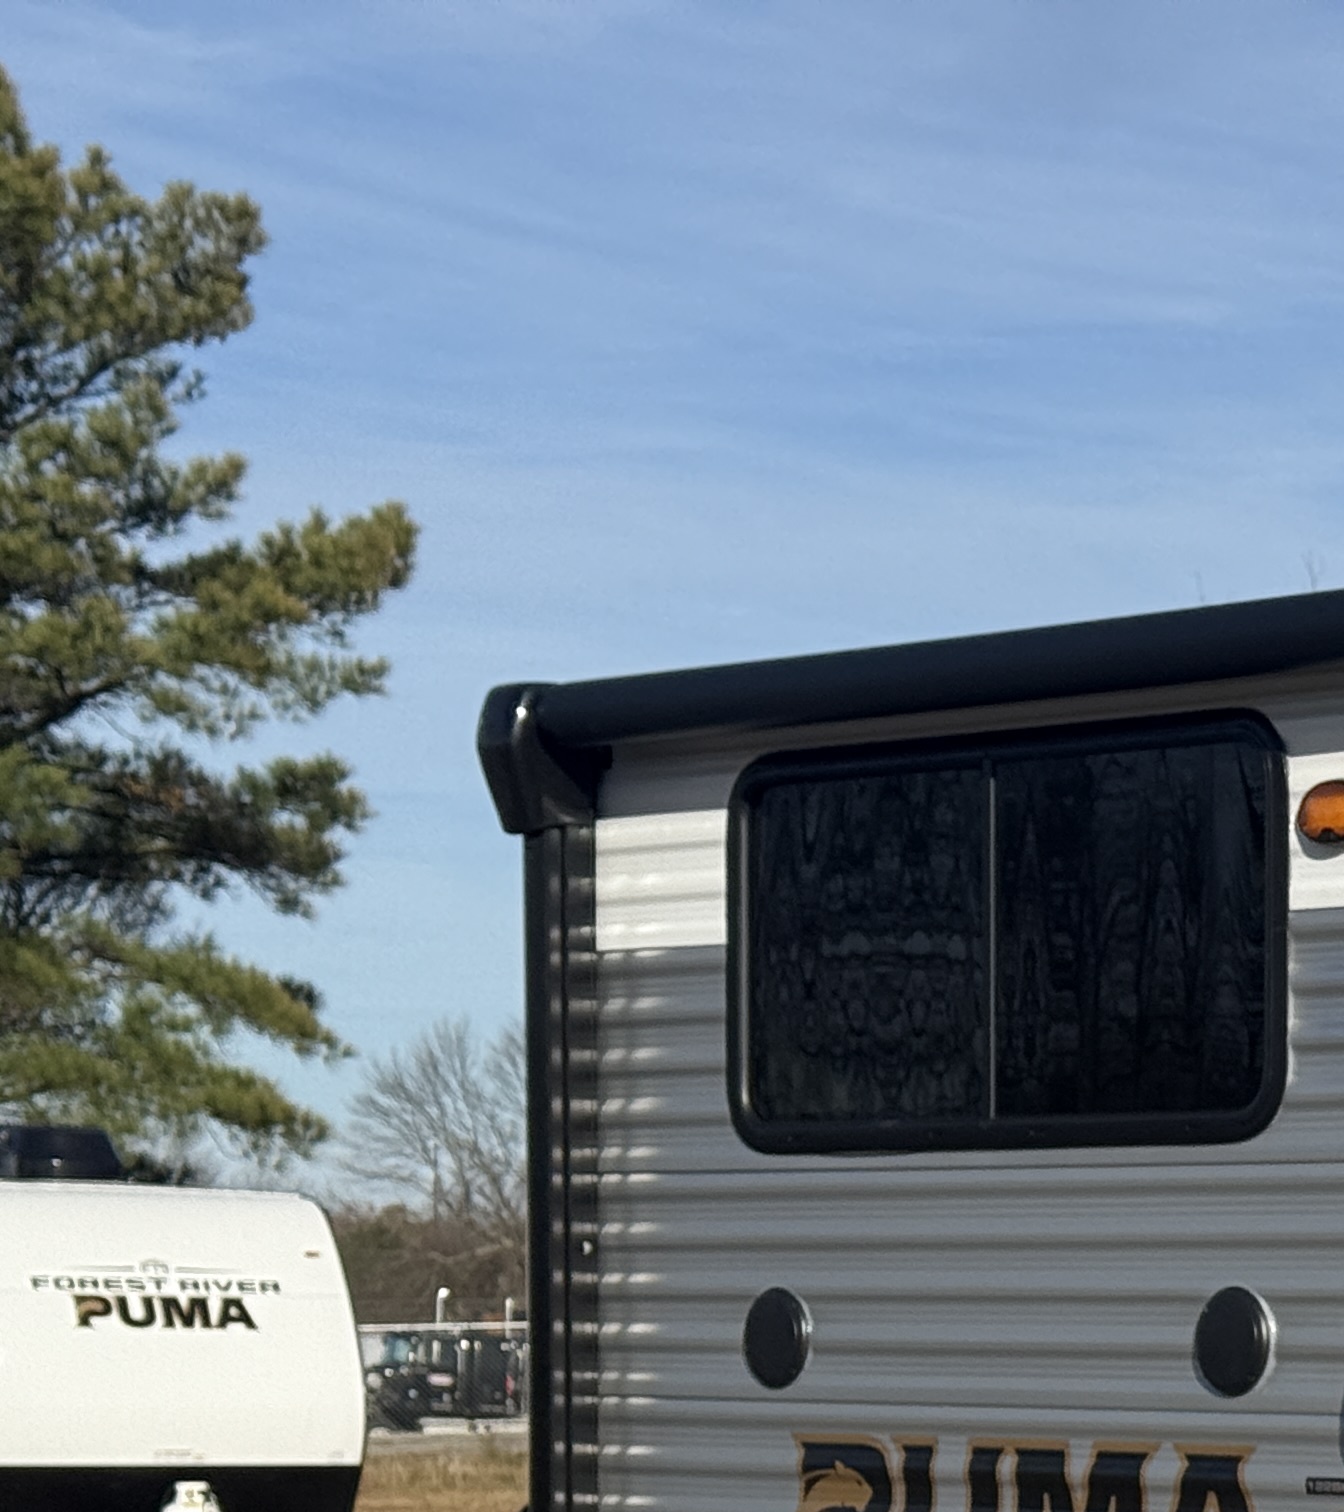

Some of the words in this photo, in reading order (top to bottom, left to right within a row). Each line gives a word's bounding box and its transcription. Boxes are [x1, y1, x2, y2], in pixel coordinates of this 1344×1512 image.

[30, 1274, 167, 1293] FOREST
[177, 1277, 282, 1295] RIVER
[72, 1294, 260, 1330] PUMA
